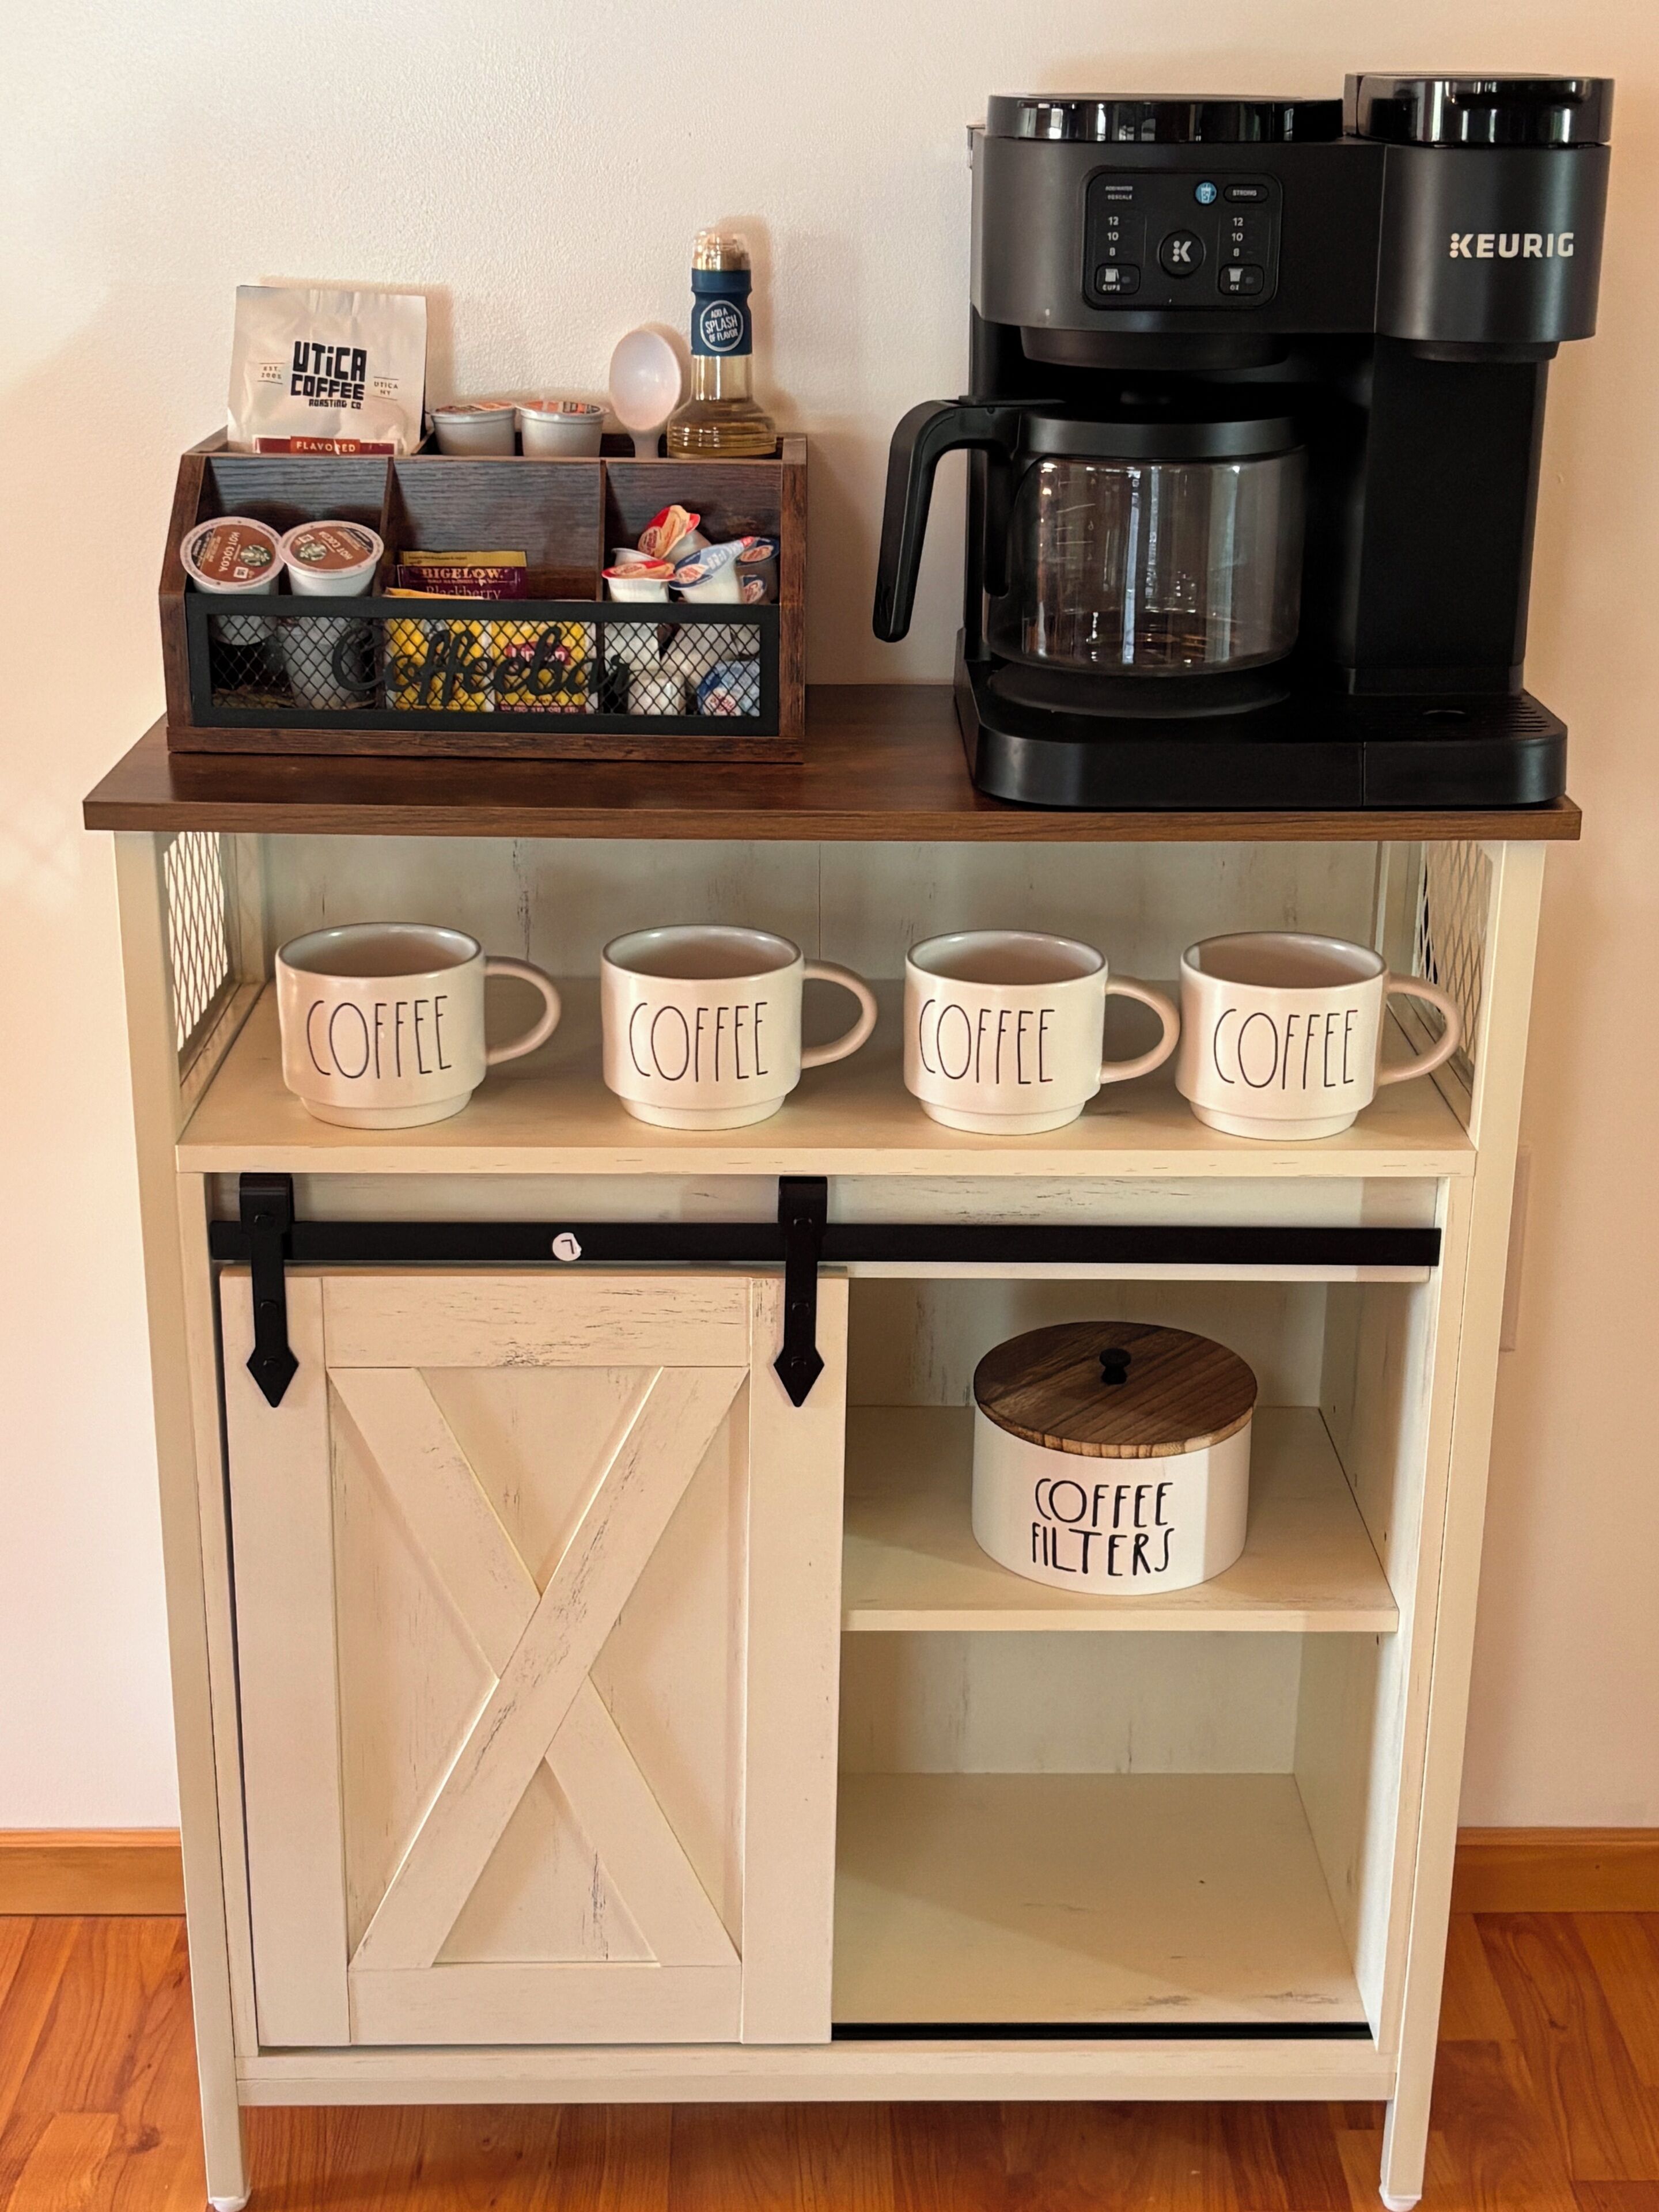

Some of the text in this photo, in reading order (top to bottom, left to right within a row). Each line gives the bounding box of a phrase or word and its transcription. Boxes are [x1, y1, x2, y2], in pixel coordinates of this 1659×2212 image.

[1108, 217, 1119, 225] 12
[1233, 218, 1244, 226] 12
[1107, 232, 1119, 241] 10
[1232, 233, 1244, 241] 10
[1449, 232, 1574, 258] KEURIG
[1109, 248, 1116, 256] 8
[1233, 248, 1240, 257] 8
[705, 315, 738, 334] SPLASH
[709, 328, 738, 343] OF FLAVOR
[290, 373, 365, 400] COFFEE
[374, 381, 399, 389] UTICA
[309, 399, 347, 408] ROASTING
[318, 531, 341, 549] COCOA
[218, 531, 240, 573] HOT COCOA
[336, 547, 354, 561] HOT
[306, 995, 452, 1080] COFFEE
[629, 1001, 768, 1083] COFFEE
[919, 999, 1055, 1085] COFFEE
[1213, 1008, 1358, 1090] COFFEE
[1035, 1478, 1174, 1529] COFFEE
[1032, 1522, 1175, 1577] FILTERS
